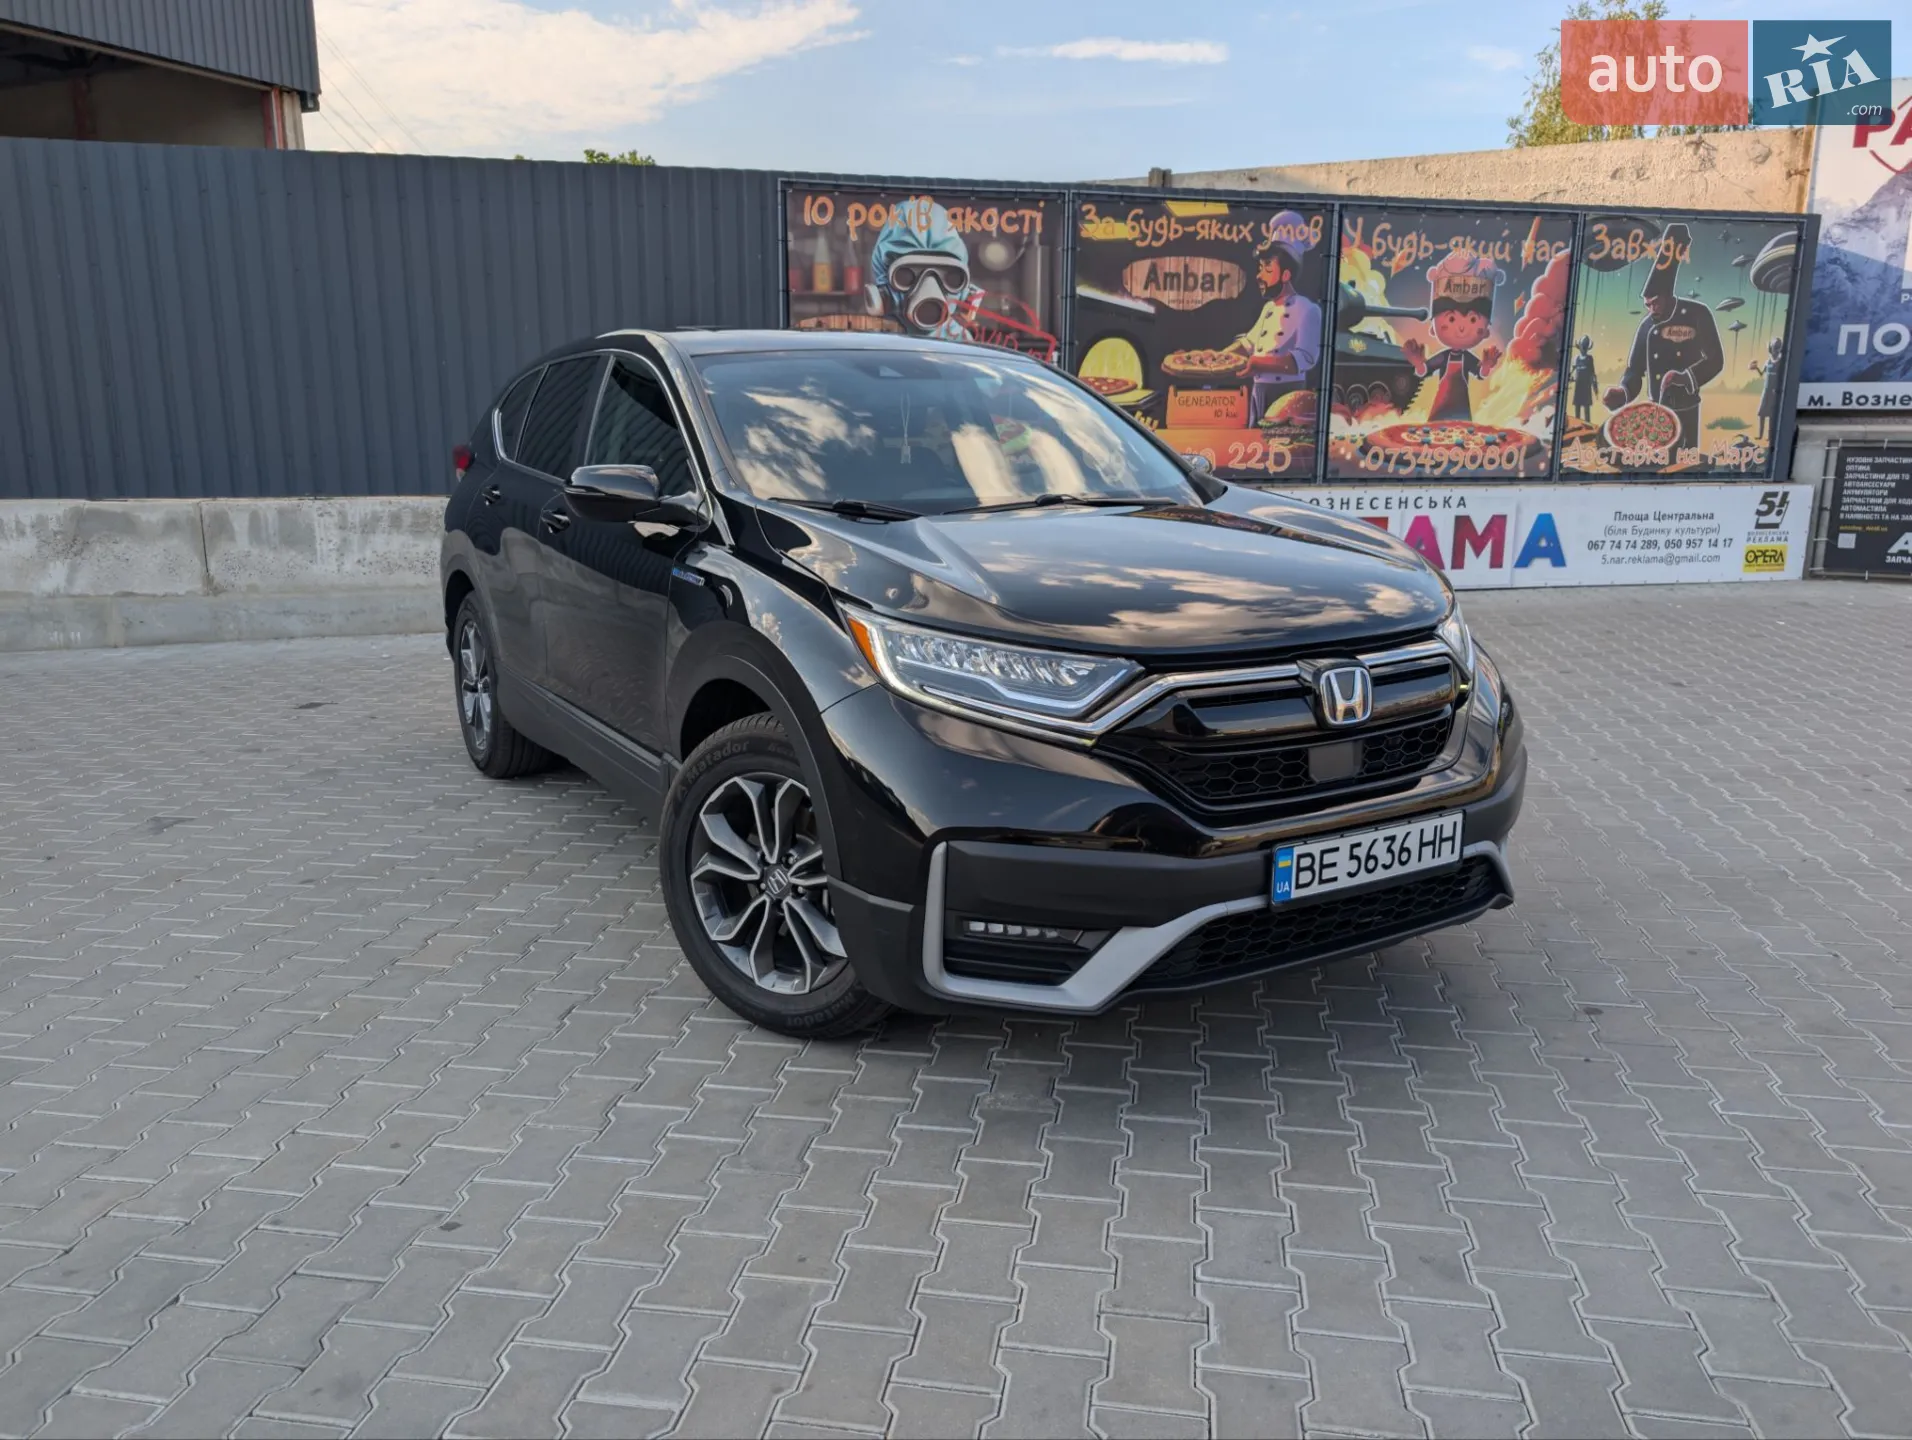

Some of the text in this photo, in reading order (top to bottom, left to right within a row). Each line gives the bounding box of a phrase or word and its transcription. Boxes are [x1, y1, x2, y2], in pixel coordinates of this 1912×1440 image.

[803, 195, 1044, 242] 10 років якості
[1080, 203, 1116, 240] За
[1126, 208, 1255, 247] будь-яких
[1372, 222, 1511, 268] будь-який
[1589, 223, 1691, 270] Завжди
[1143, 263, 1232, 293] Ambar
[1443, 279, 1487, 295] Ambar
[1178, 395, 1236, 408] GENERATOR
[1807, 394, 1832, 407] м.
[1214, 408, 1223, 418] 10
[1562, 436, 1766, 473] Доставка на Марс
[1298, 495, 1467, 512] ОЗНЕСЕНСЬКА
[1613, 511, 1715, 523] Площа Центральна
[1604, 524, 1721, 537] (біля Будинку культури)
[1587, 538, 1733, 551] 067 74 74 289, 050 957 14 17
[1746, 535, 1788, 543] РЕКЛАМА
[1601, 553, 1721, 566] 5.nar.reklama@gmail.com
[1744, 549, 1785, 563] OPERA
[1295, 820, 1458, 890] BE 5636 HH
[1276, 881, 1290, 894] UA
